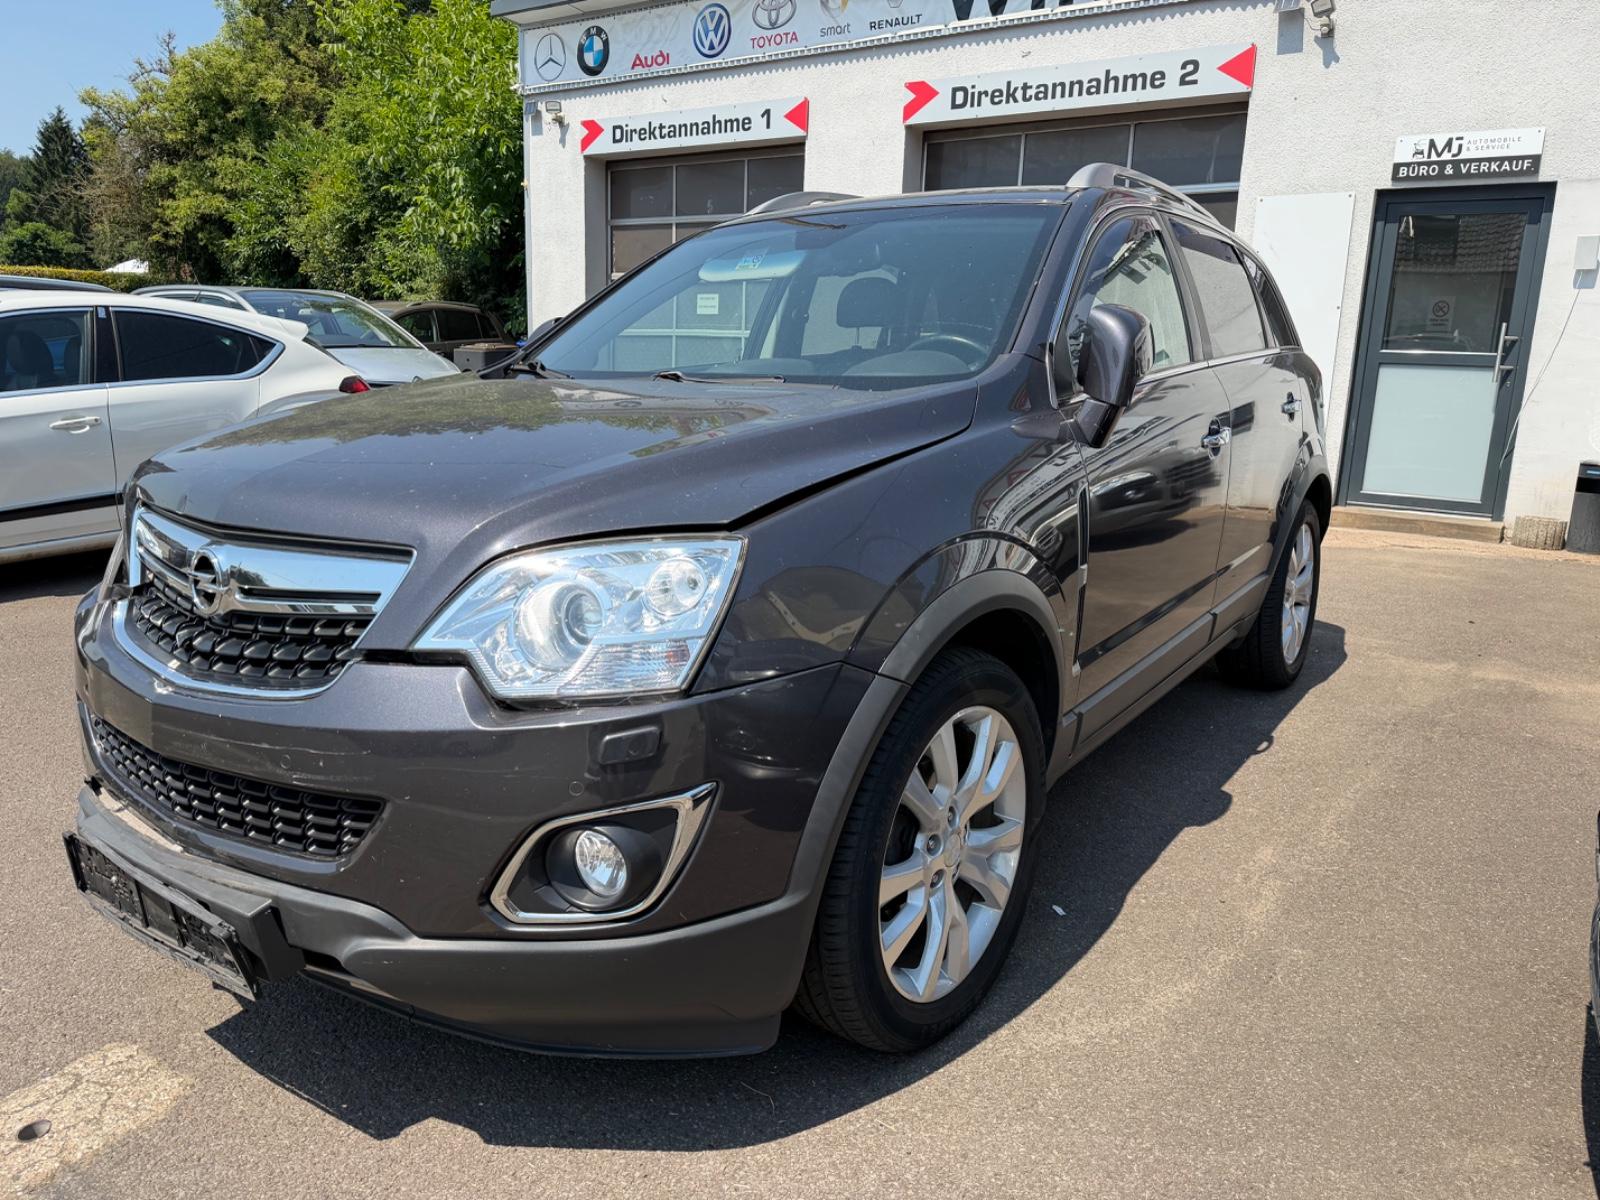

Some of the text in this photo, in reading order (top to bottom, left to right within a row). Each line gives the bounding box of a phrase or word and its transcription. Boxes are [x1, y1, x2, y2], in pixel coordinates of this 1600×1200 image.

[820, 22, 851, 37] smart
[869, 14, 922, 31] RENAULT
[580, 26, 608, 44] BMW
[751, 32, 798, 49] TOYOTA
[631, 50, 669, 70] Audi
[950, 59, 1200, 110] Direktannahme 2
[612, 108, 772, 144] Direktannahme 1
[1467, 136, 1522, 145] AUTOMOBILE
[1475, 143, 1511, 151] SERVICE
[1399, 164, 1439, 177] BÜRO
[1444, 163, 1454, 175] &
